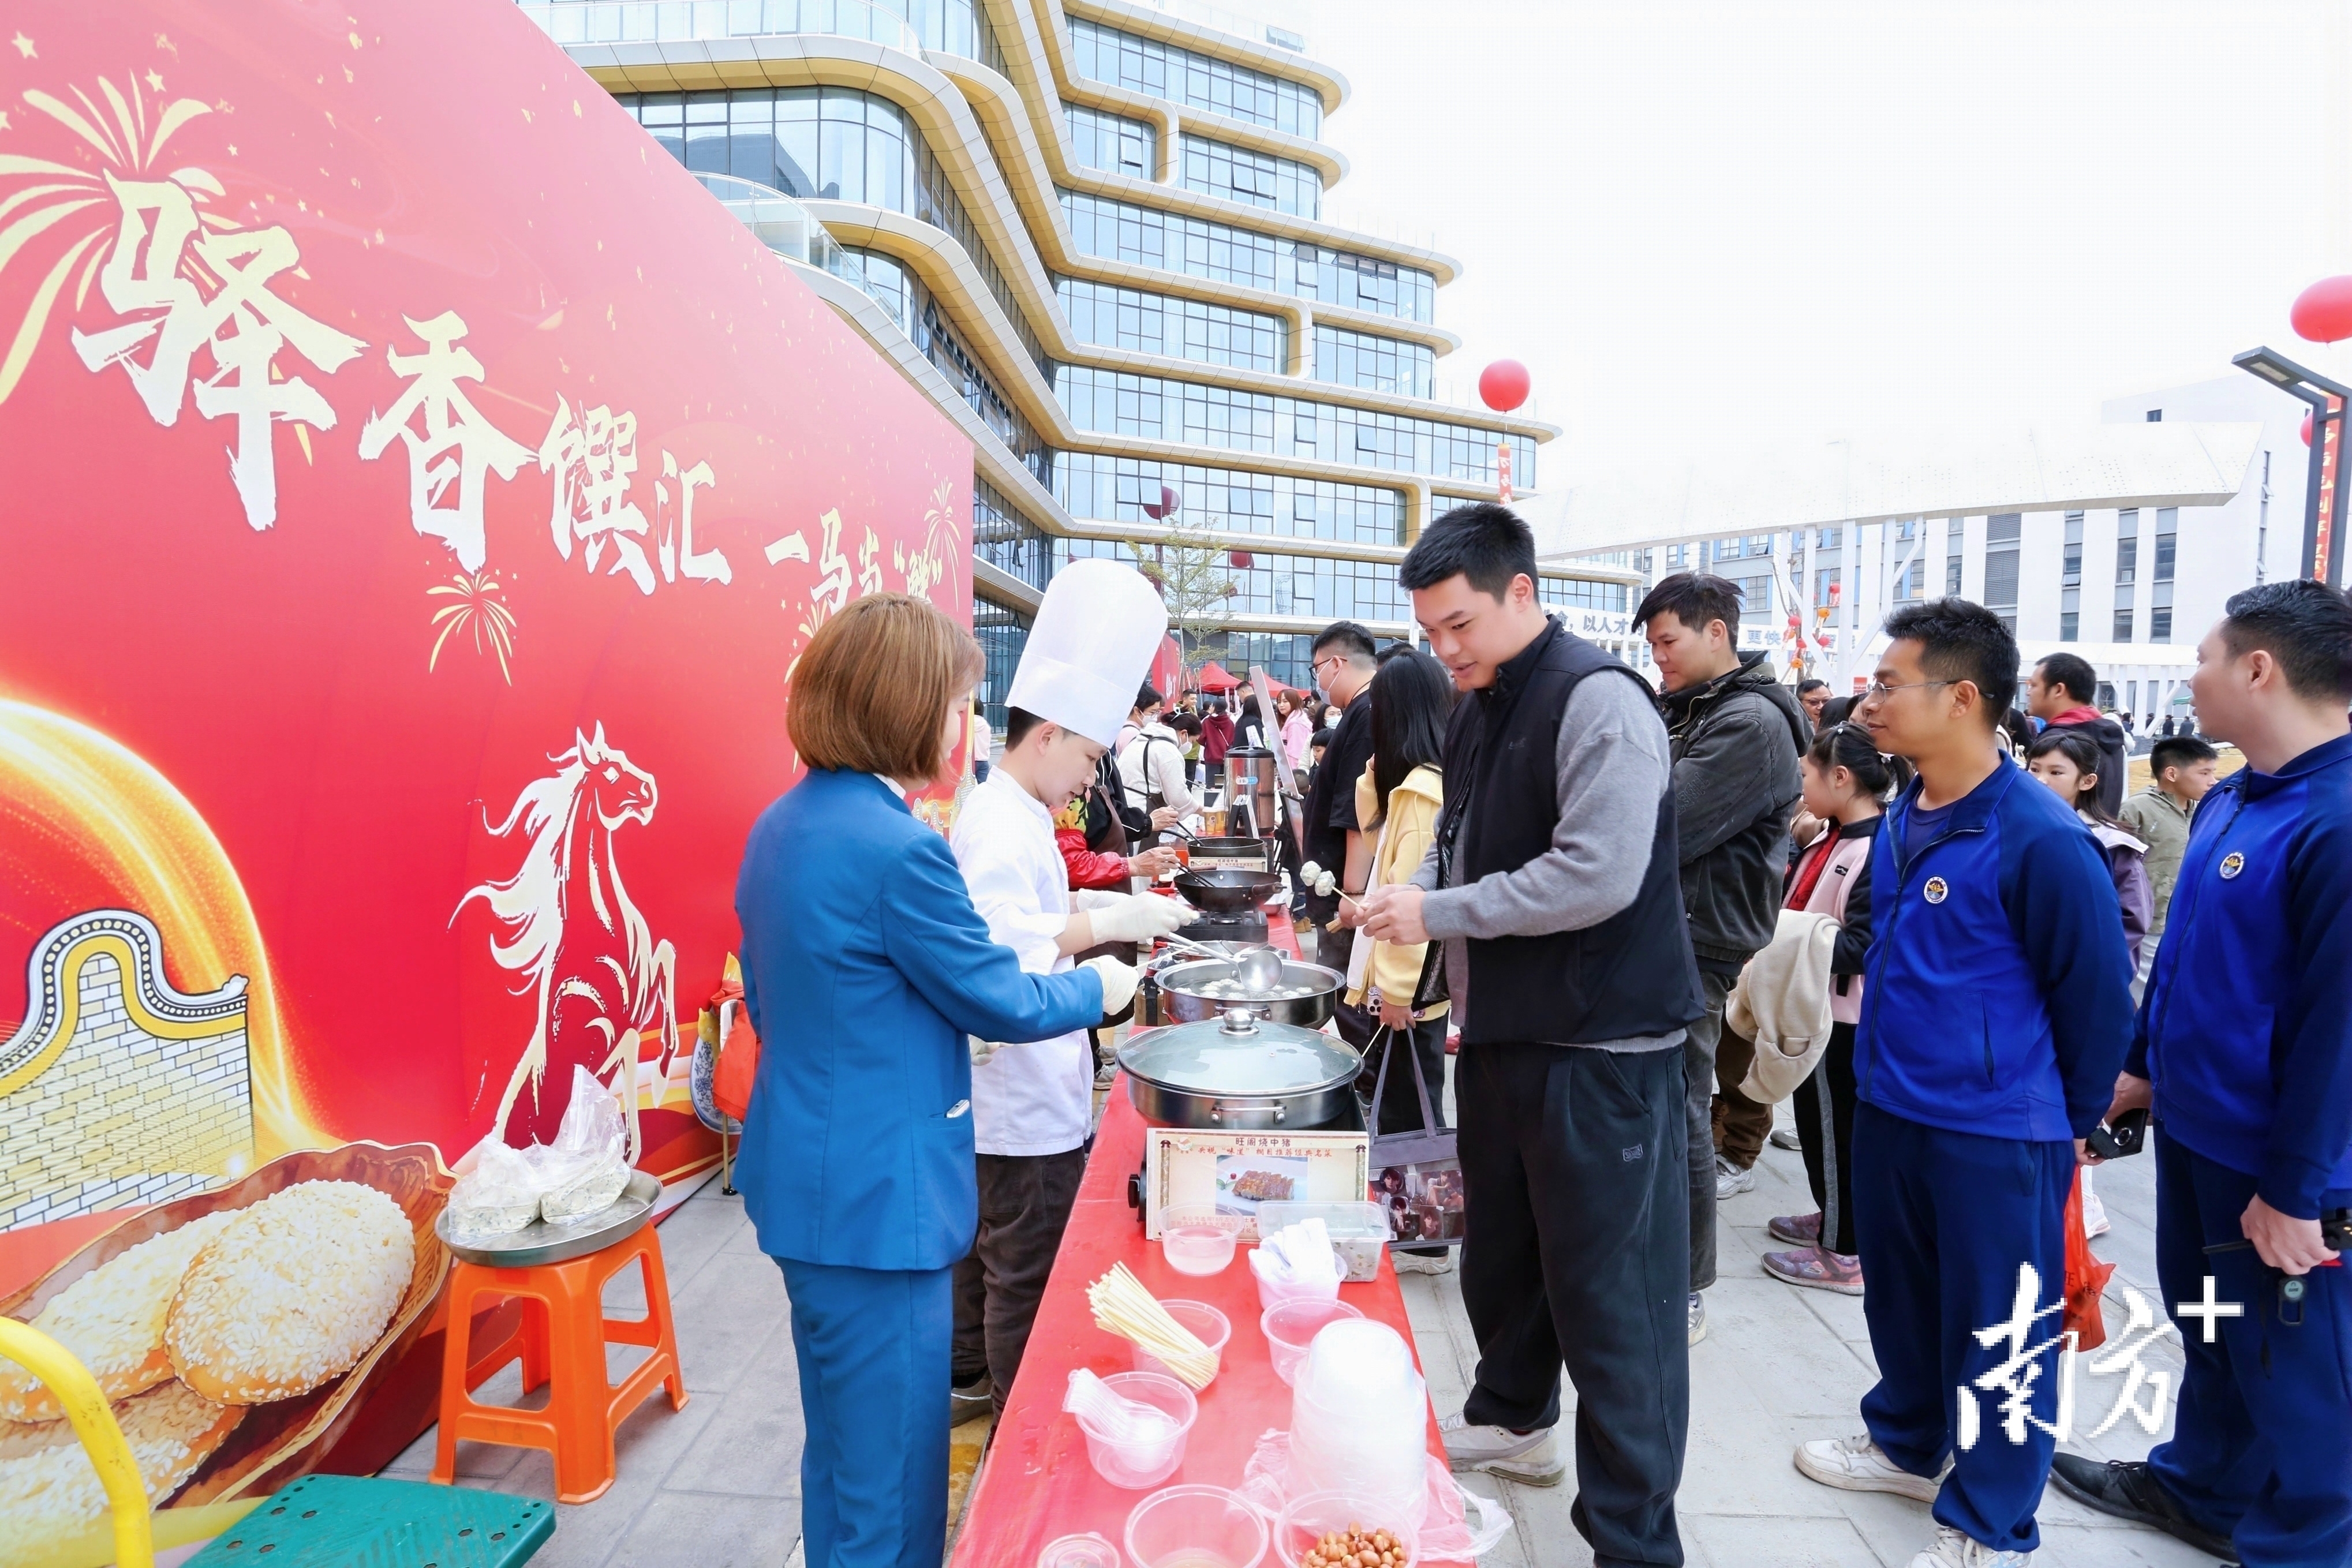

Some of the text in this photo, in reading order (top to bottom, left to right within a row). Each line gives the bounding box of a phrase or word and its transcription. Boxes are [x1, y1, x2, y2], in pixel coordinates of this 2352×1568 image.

[1235, 1137, 1291, 1147] 旺阁烧中猪
